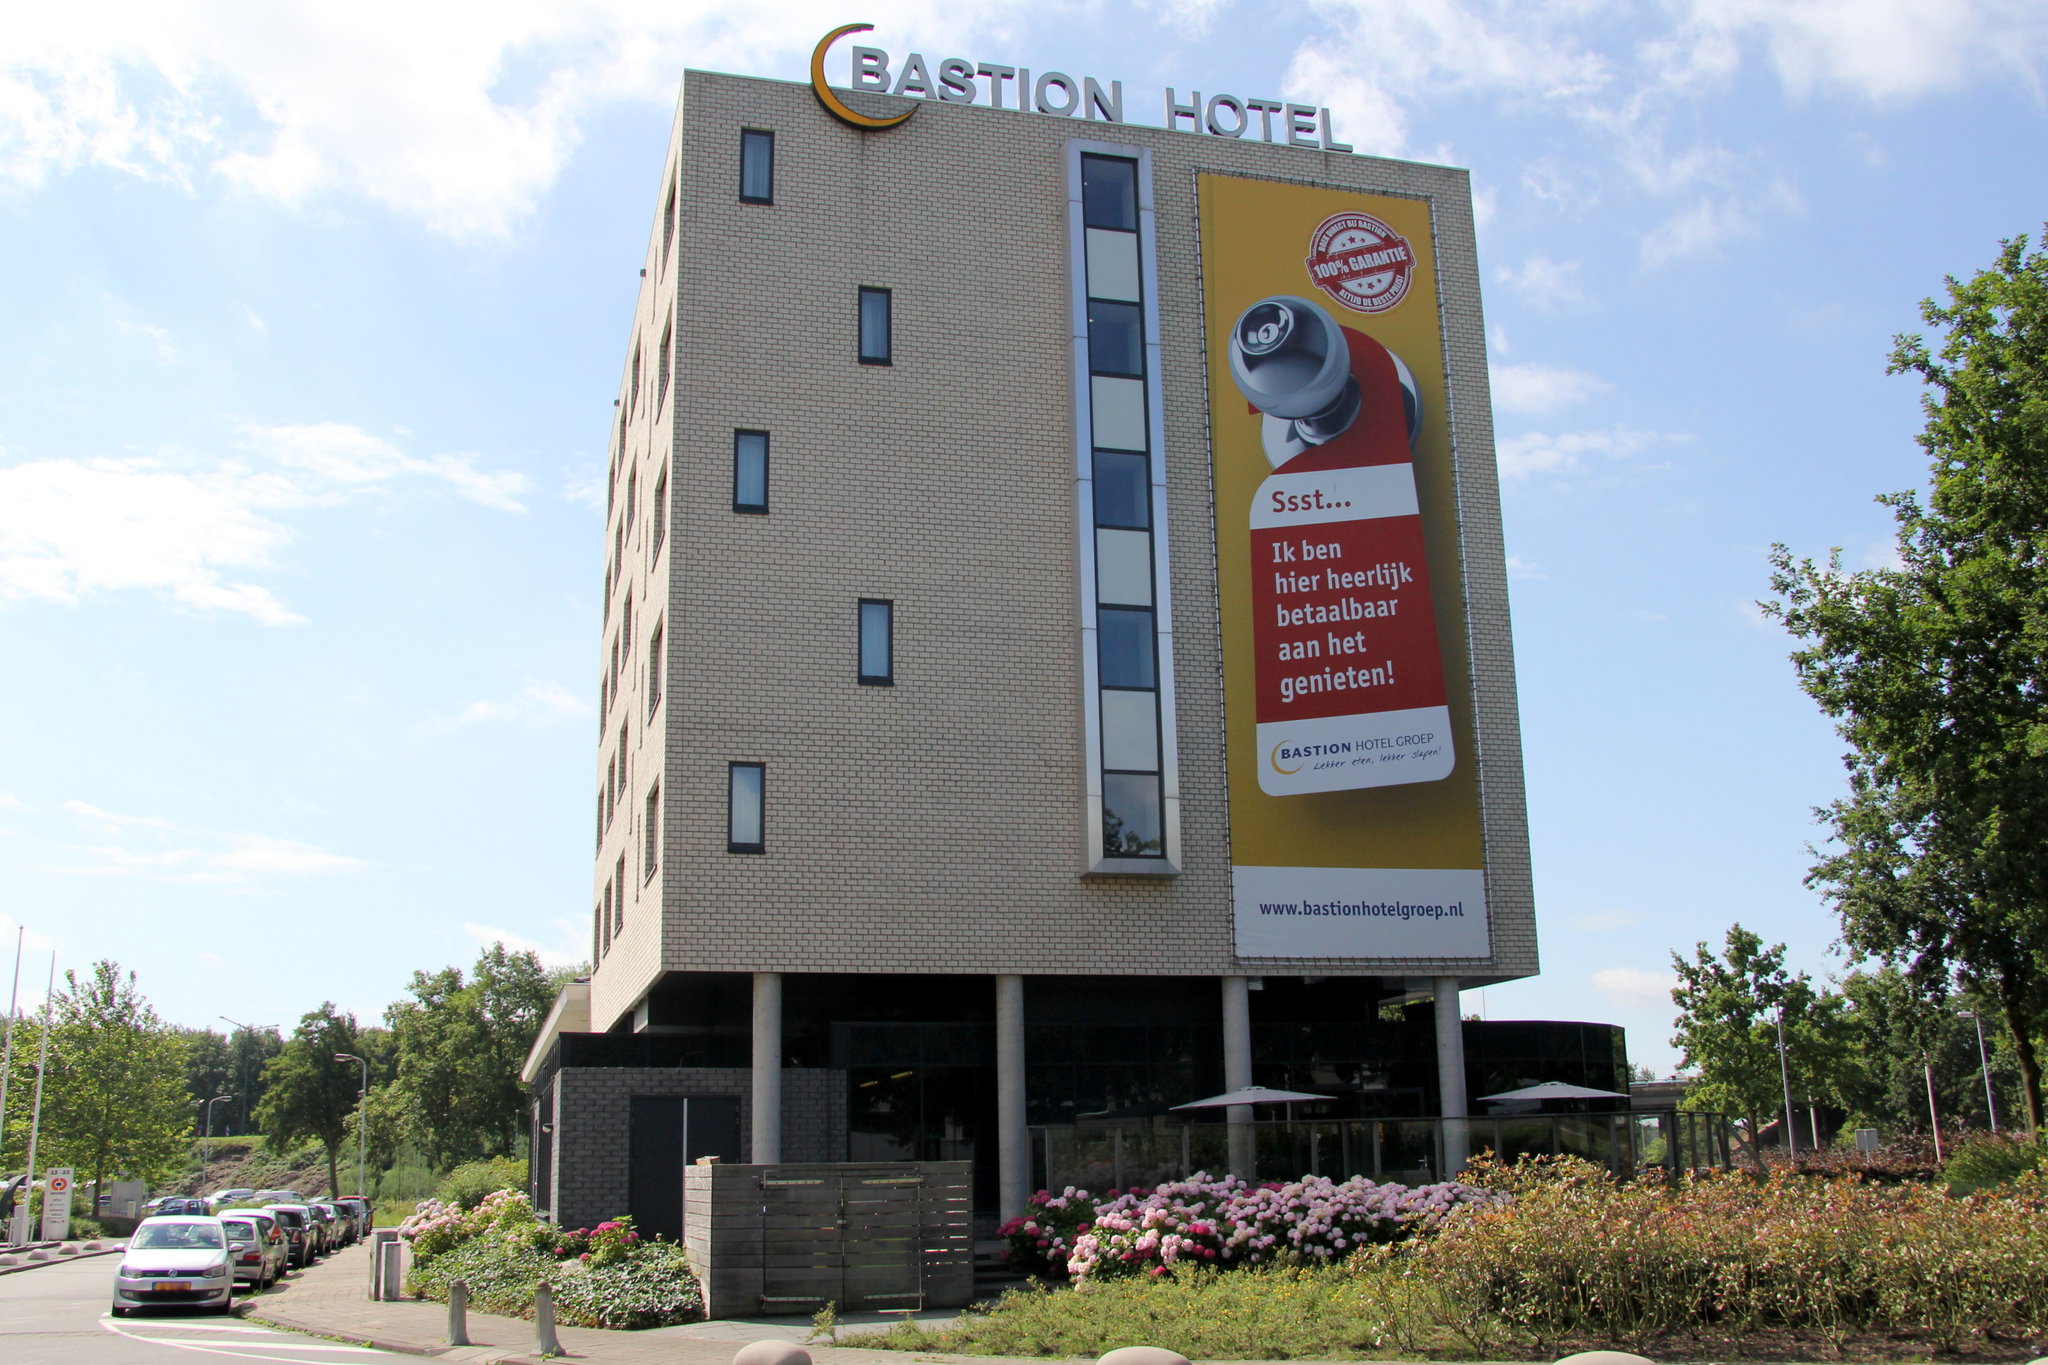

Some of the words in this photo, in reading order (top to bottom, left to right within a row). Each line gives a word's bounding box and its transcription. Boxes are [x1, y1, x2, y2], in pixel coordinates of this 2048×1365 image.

[851, 46, 1122, 123] BASTION
[1165, 87, 1353, 153] HOTEL
[1325, 221, 1346, 237] DIRECT
[1358, 220, 1387, 238] BASTION
[1313, 260, 1349, 279] 100%
[1348, 246, 1408, 271] GARANTIE
[1338, 289, 1361, 304] ALTIJD
[1362, 298, 1372, 306] DE
[1372, 292, 1393, 306] BESTE
[1271, 489, 1351, 513] Ssst...
[1272, 541, 1296, 563] Ik
[1302, 539, 1342, 561] ben
[1275, 571, 1320, 594] hier
[1327, 561, 1413, 590] heerlijk
[1276, 597, 1398, 627] betaalbaar
[1278, 638, 1320, 661] aan
[1327, 631, 1366, 656] het
[1280, 660, 1395, 703] genieten!
[1281, 742, 1351, 760] BASTION
[1313, 760, 1346, 770] Lekker
[1351, 757, 1374, 767] eten,
[1379, 753, 1406, 763] lekker
[1411, 746, 1442, 761] slapen!
[1260, 900, 1464, 920] www.bastionhotelgroep.nl
